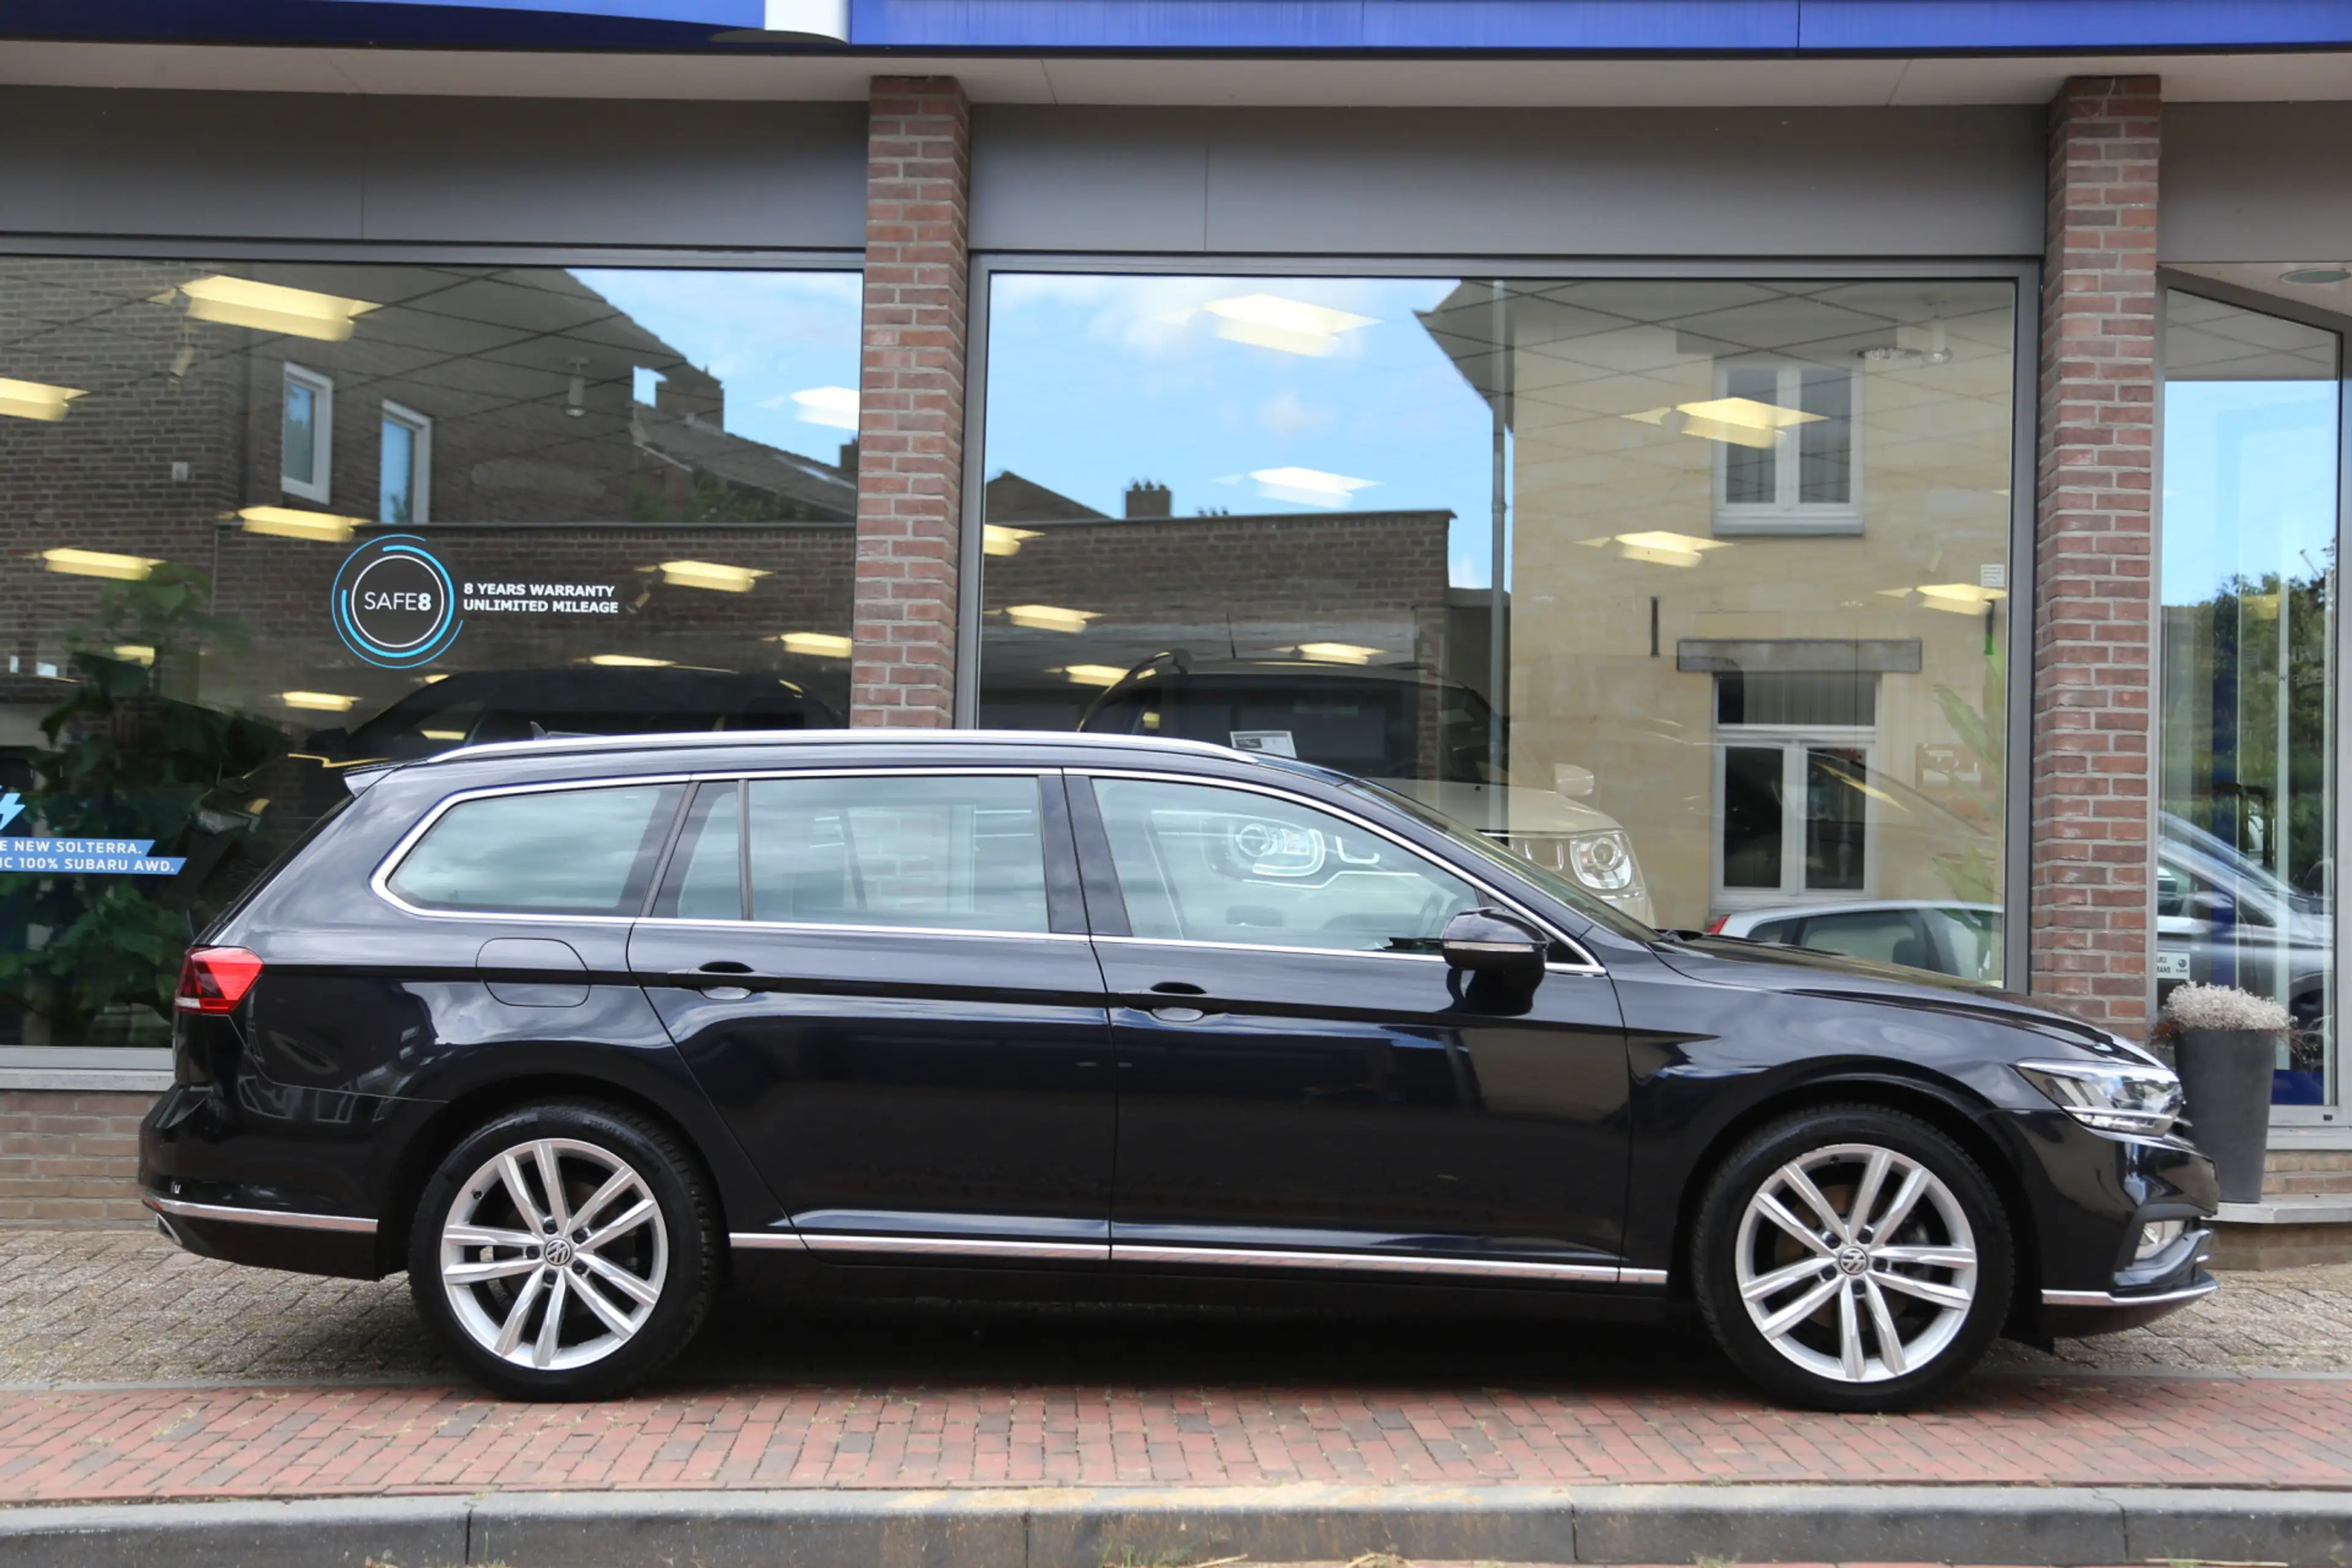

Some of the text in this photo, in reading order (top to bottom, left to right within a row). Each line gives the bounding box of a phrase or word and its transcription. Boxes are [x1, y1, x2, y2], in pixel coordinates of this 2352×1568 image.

[464, 582, 615, 597] 8 YEARS WARRANTY
[364, 591, 432, 611] SAFE8
[463, 598, 619, 614] UNLIMITED MILEAGE
[15, 840, 50, 852] NEW
[56, 841, 141, 854] SOLTERRA.
[19, 857, 58, 869] 100%
[64, 858, 128, 870] SUBARU
[134, 860, 175, 872] AWD.
